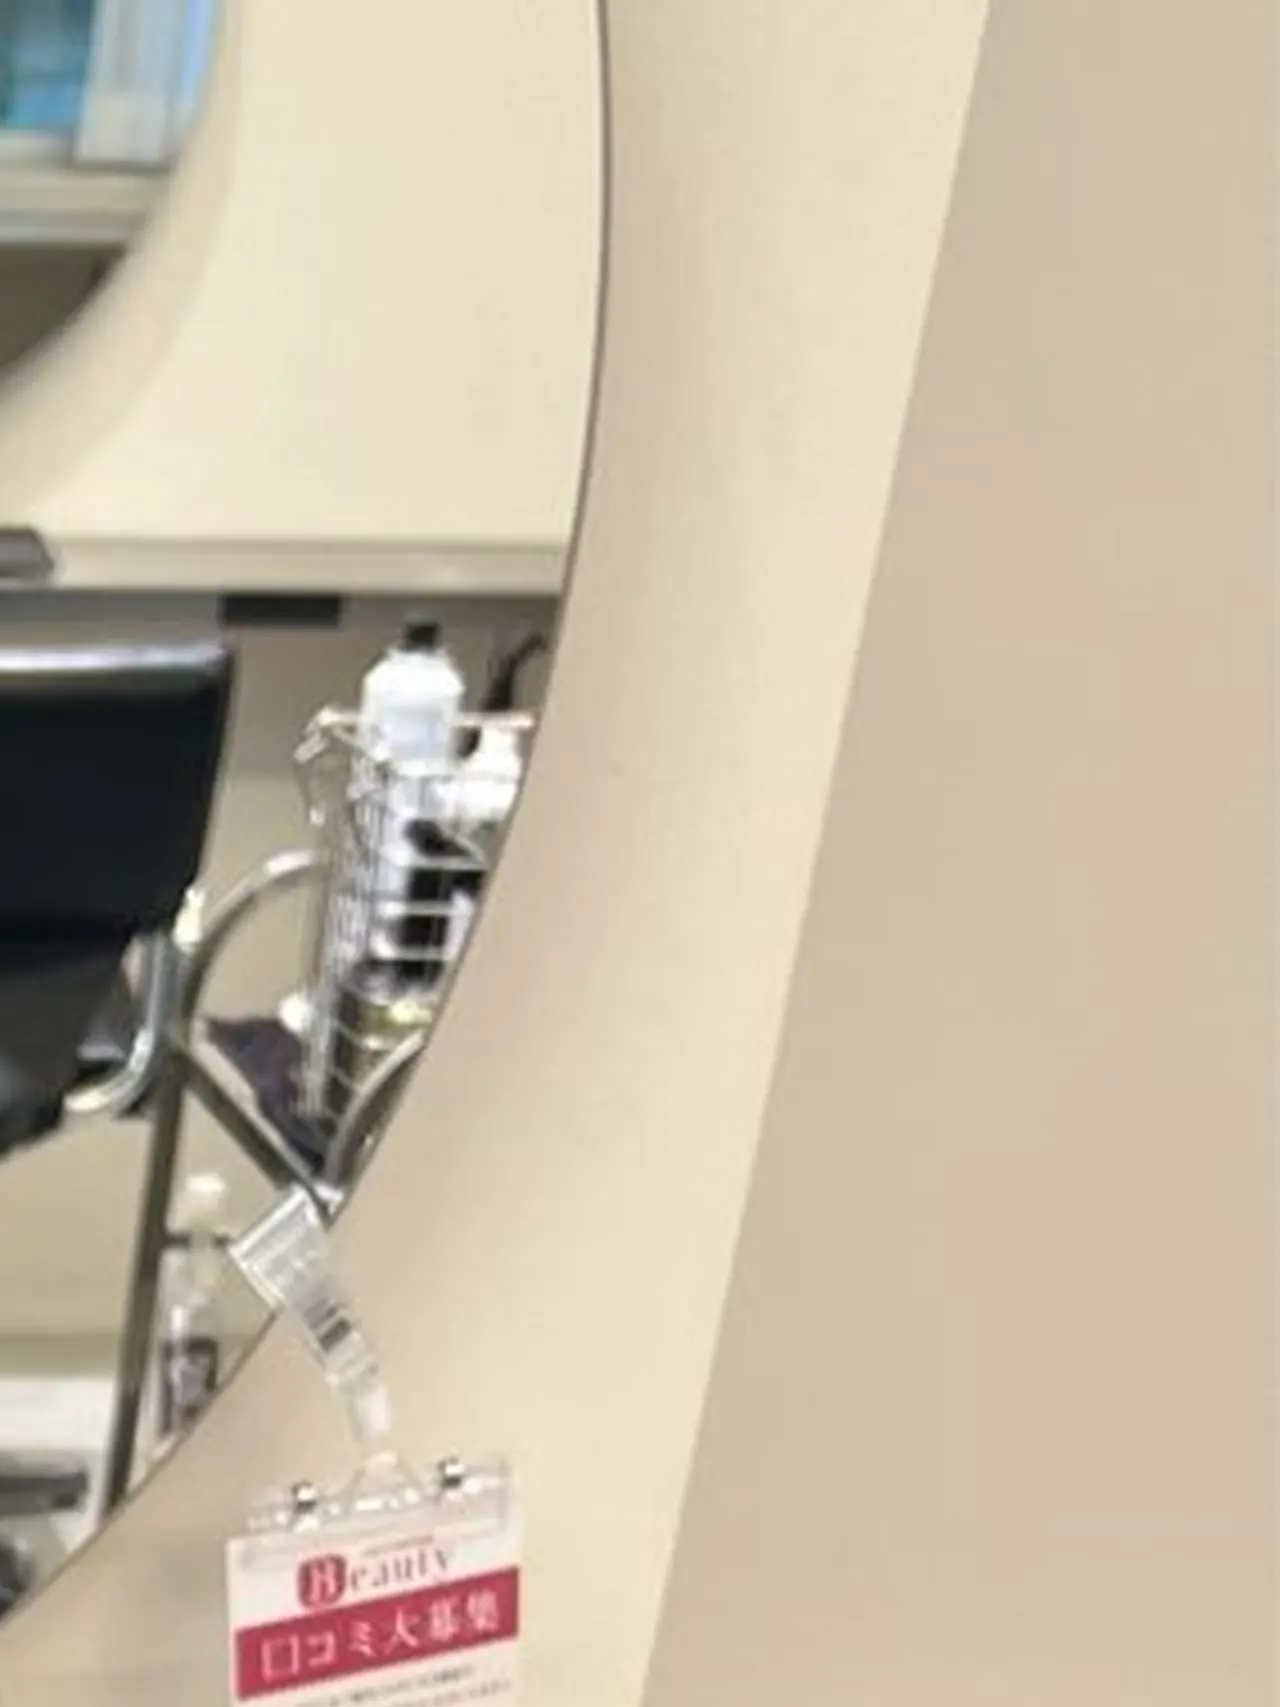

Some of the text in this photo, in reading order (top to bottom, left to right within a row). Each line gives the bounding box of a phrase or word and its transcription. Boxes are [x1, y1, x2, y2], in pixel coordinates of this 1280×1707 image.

[299, 1549, 449, 1607] Beauty
[260, 1587, 499, 1684] 口コミ大募集
